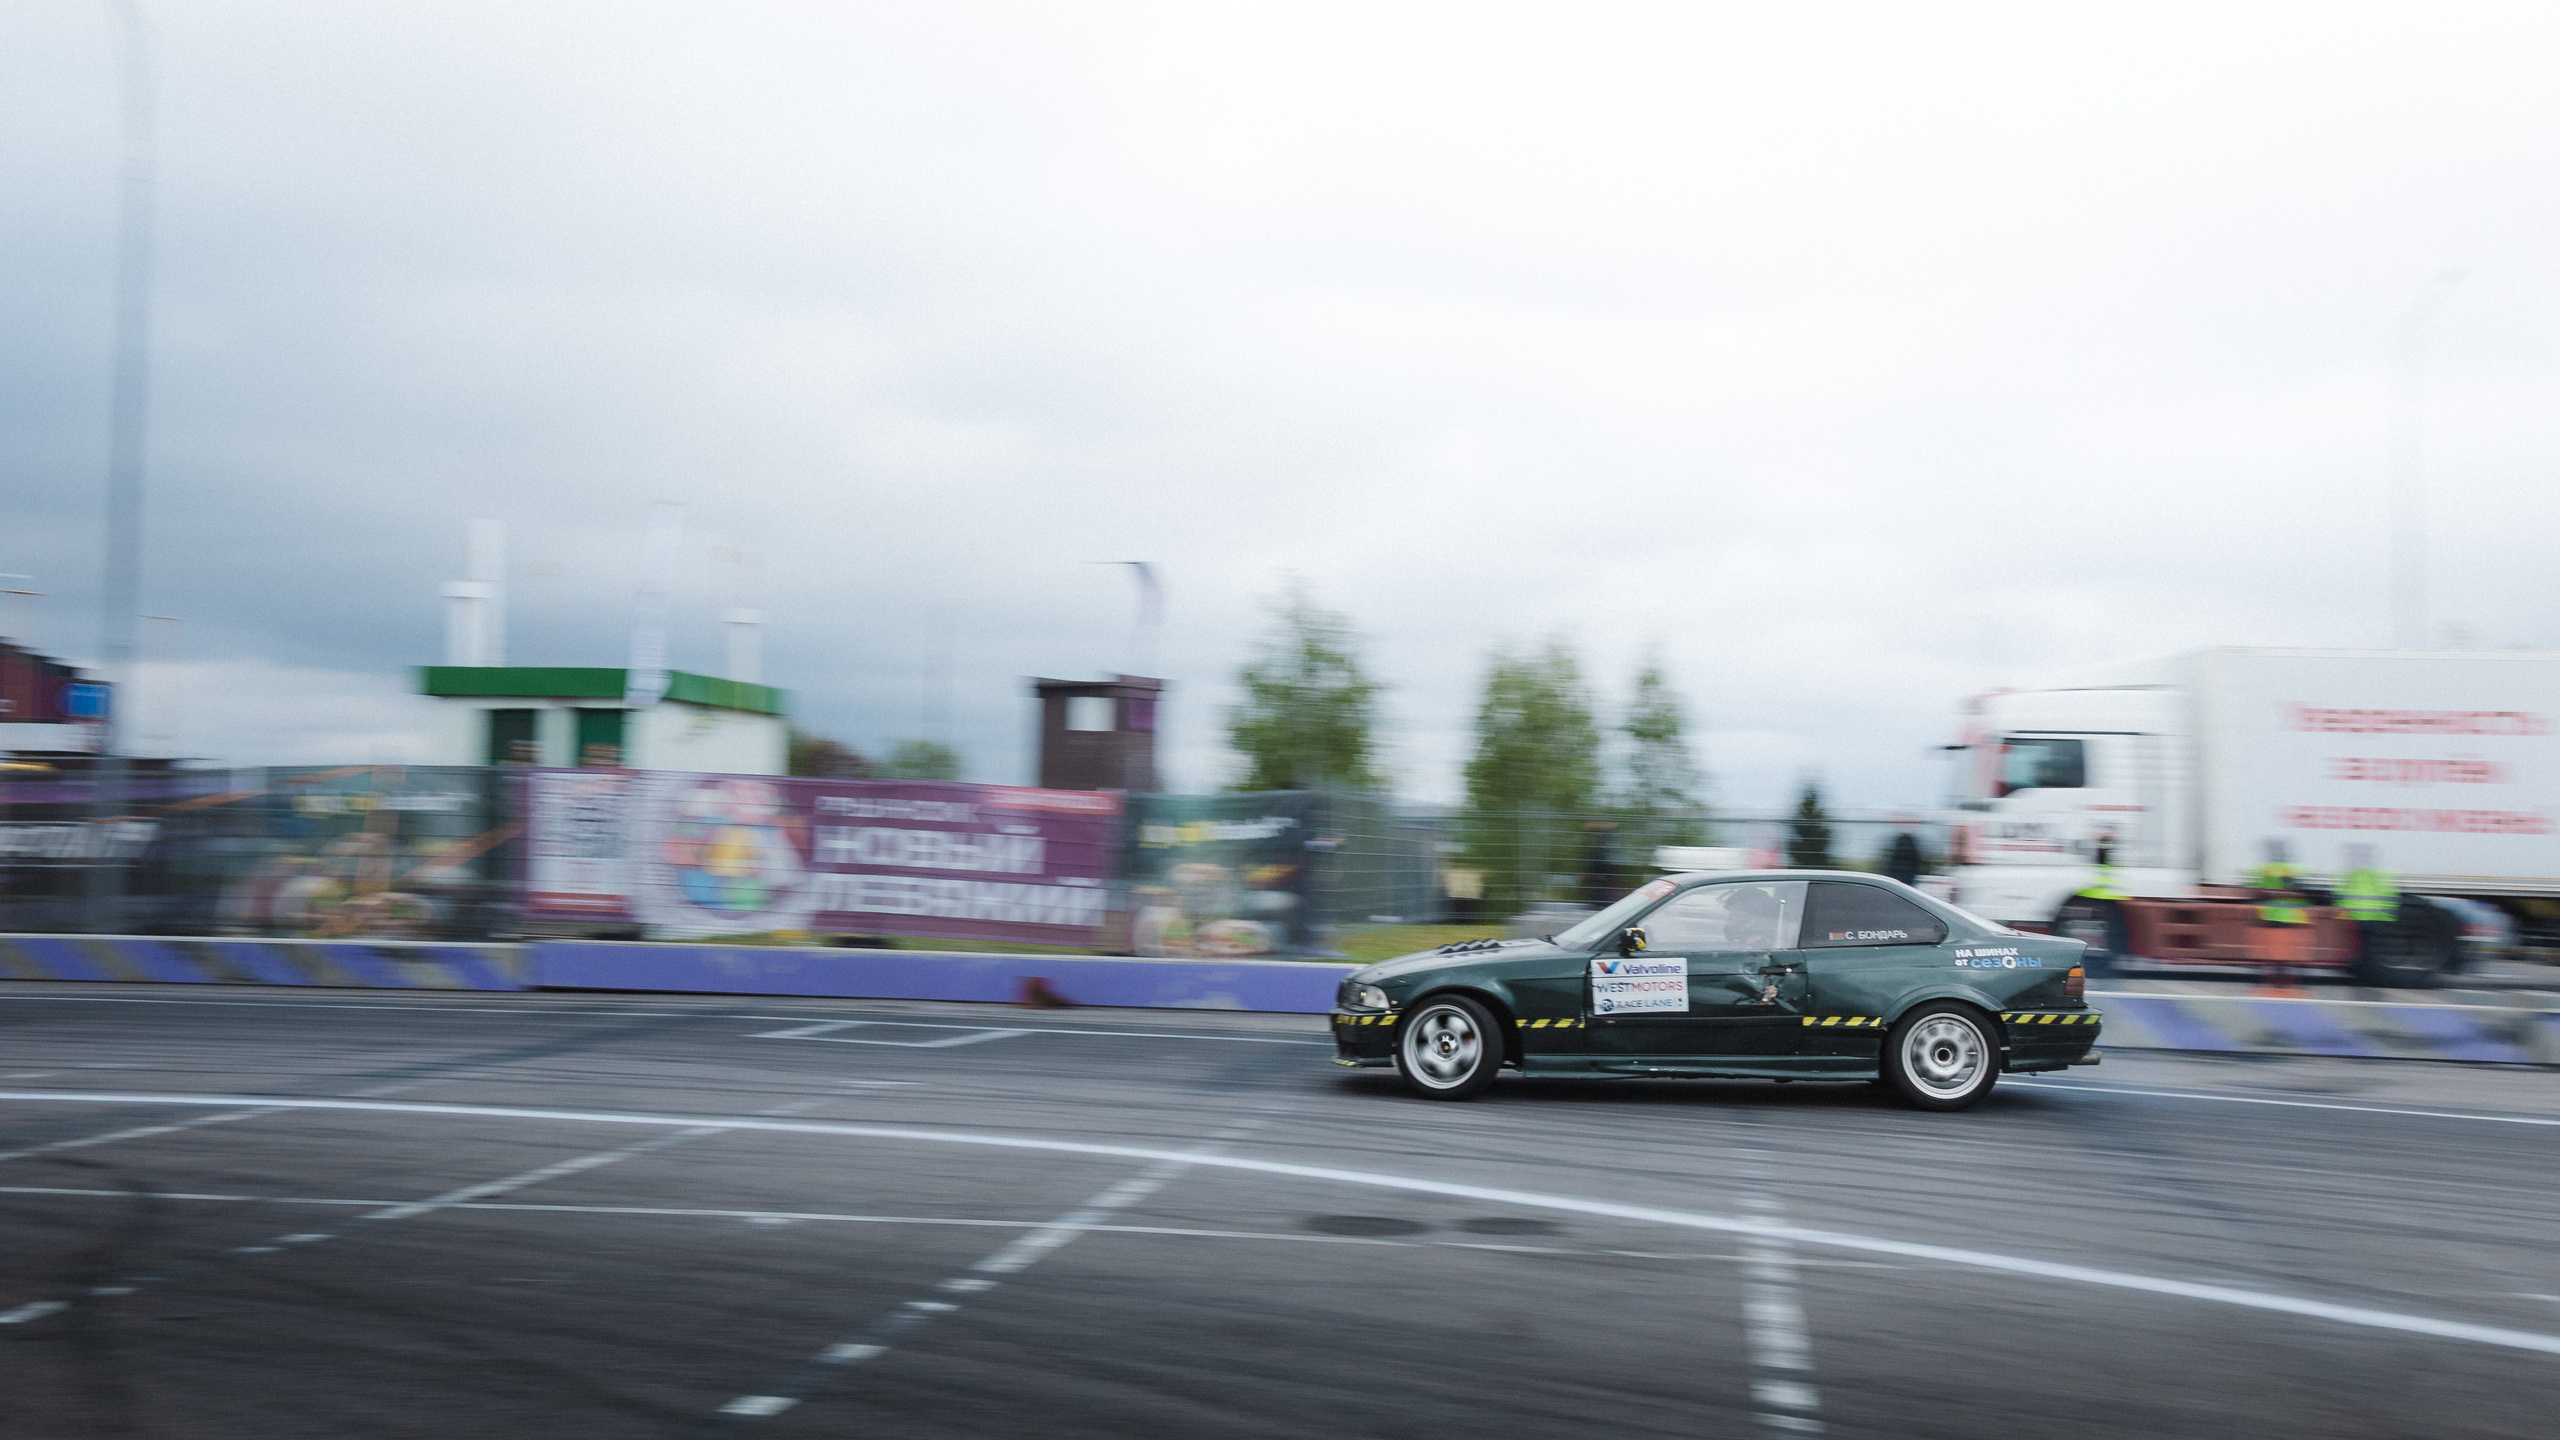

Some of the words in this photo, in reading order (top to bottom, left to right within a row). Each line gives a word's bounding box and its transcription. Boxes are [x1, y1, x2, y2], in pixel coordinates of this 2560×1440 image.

[812, 824, 1046, 875] НОВЫЙ
[1857, 929, 1908, 940] БОНДАРЬ
[1954, 948, 1973, 958] НА
[1974, 947, 2019, 957] ШИНАХ
[1622, 963, 1682, 975] Valvoline
[1598, 981, 1684, 993] WESTMOTORS
[1615, 999, 1643, 1009] RACE
[1644, 999, 1673, 1008] LANE
